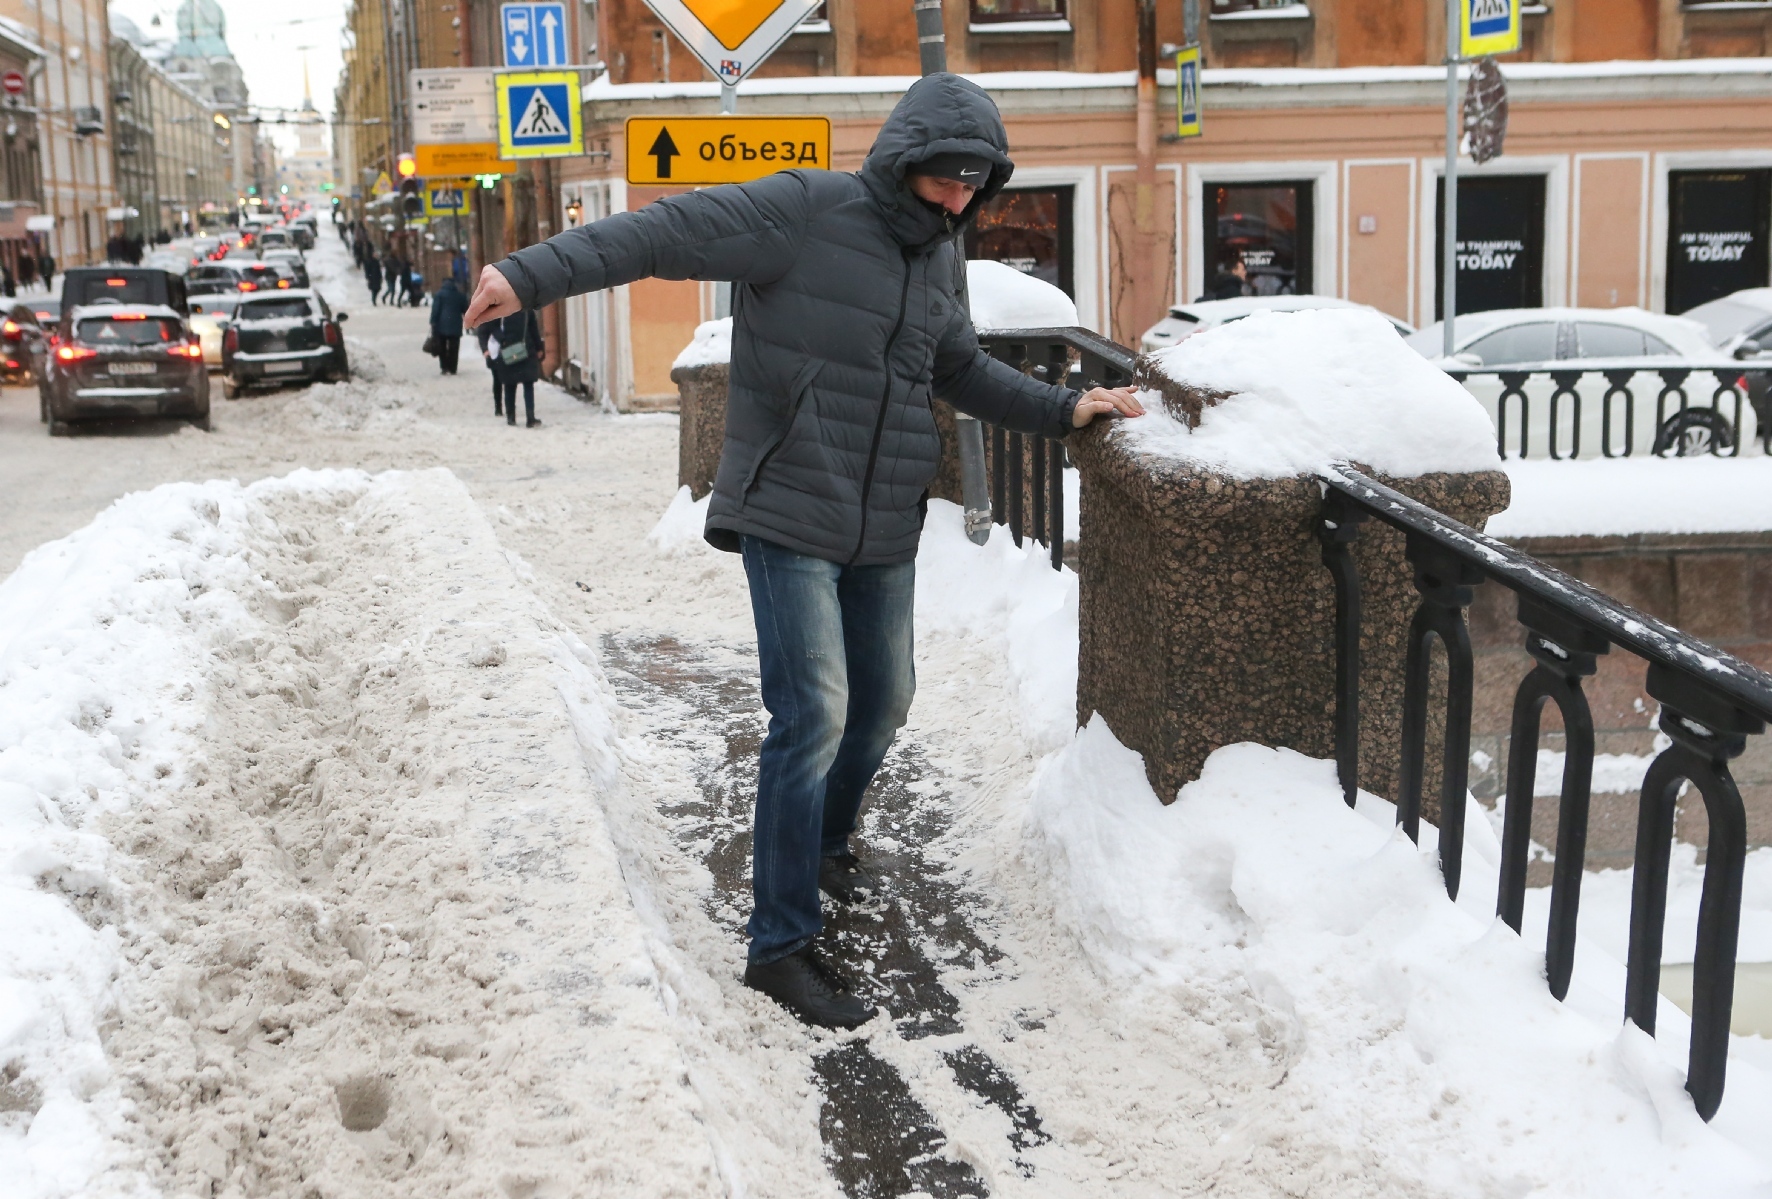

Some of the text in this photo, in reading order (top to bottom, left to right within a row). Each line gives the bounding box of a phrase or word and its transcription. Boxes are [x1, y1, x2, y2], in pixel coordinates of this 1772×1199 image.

[698, 133, 818, 165] объезд
[1467, 240, 1524, 251] THANKFUL
[1686, 244, 1746, 262] TODAY
[1456, 253, 1516, 270] TODAY
